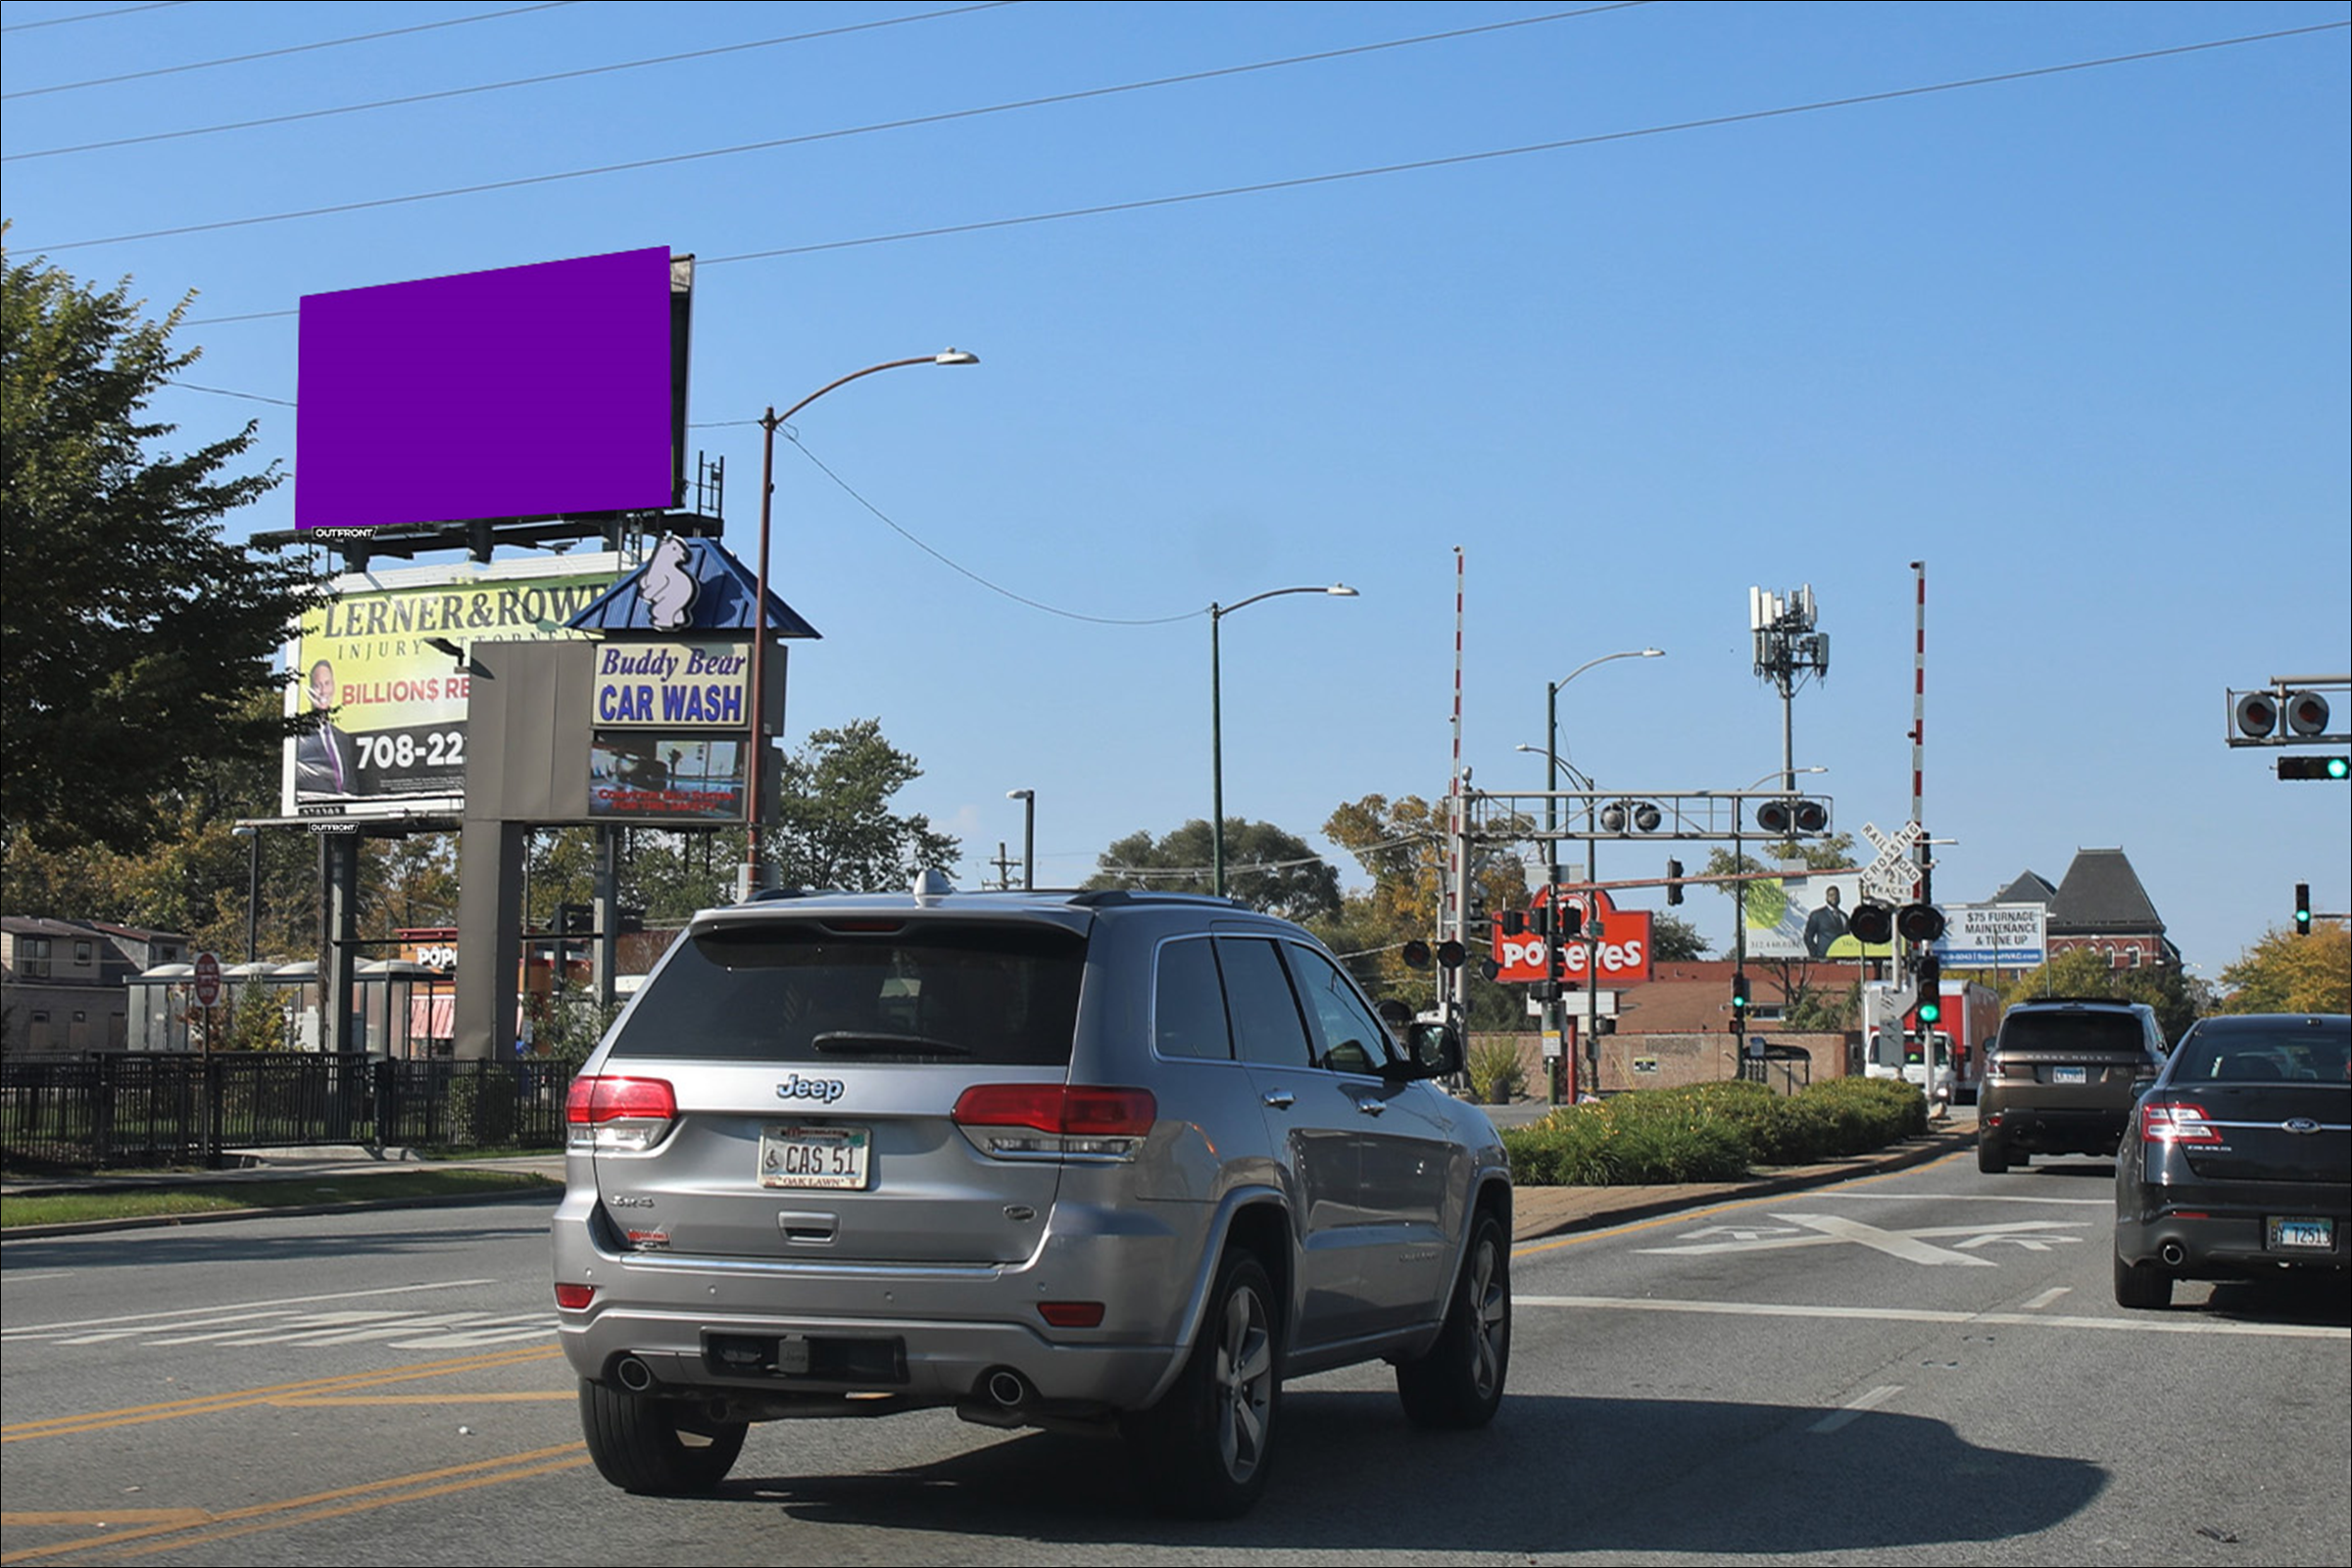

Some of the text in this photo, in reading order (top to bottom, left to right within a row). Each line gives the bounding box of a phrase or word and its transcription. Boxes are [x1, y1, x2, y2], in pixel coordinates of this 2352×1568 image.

[316, 528, 373, 538] OUTFRONT
[338, 638, 423, 662] INJURY
[600, 647, 746, 682] Buddy Bear
[342, 677, 470, 705] BILLION$ RE
[599, 684, 743, 721] CAR WASH
[356, 731, 467, 769] 708-22
[1862, 824, 1886, 854] RAIL
[1863, 824, 1920, 882] CROSSING
[1964, 922, 2038, 934] MAINTENANCE
[1966, 910, 1986, 922] $75
[1985, 935, 2011, 946] TUNE
[2014, 935, 2029, 945] UP
[417, 946, 458, 969] POP
[776, 1074, 845, 1103] Jeep
[786, 1146, 856, 1175] CAS 51
[783, 1177, 840, 1187] OAK LAWN
